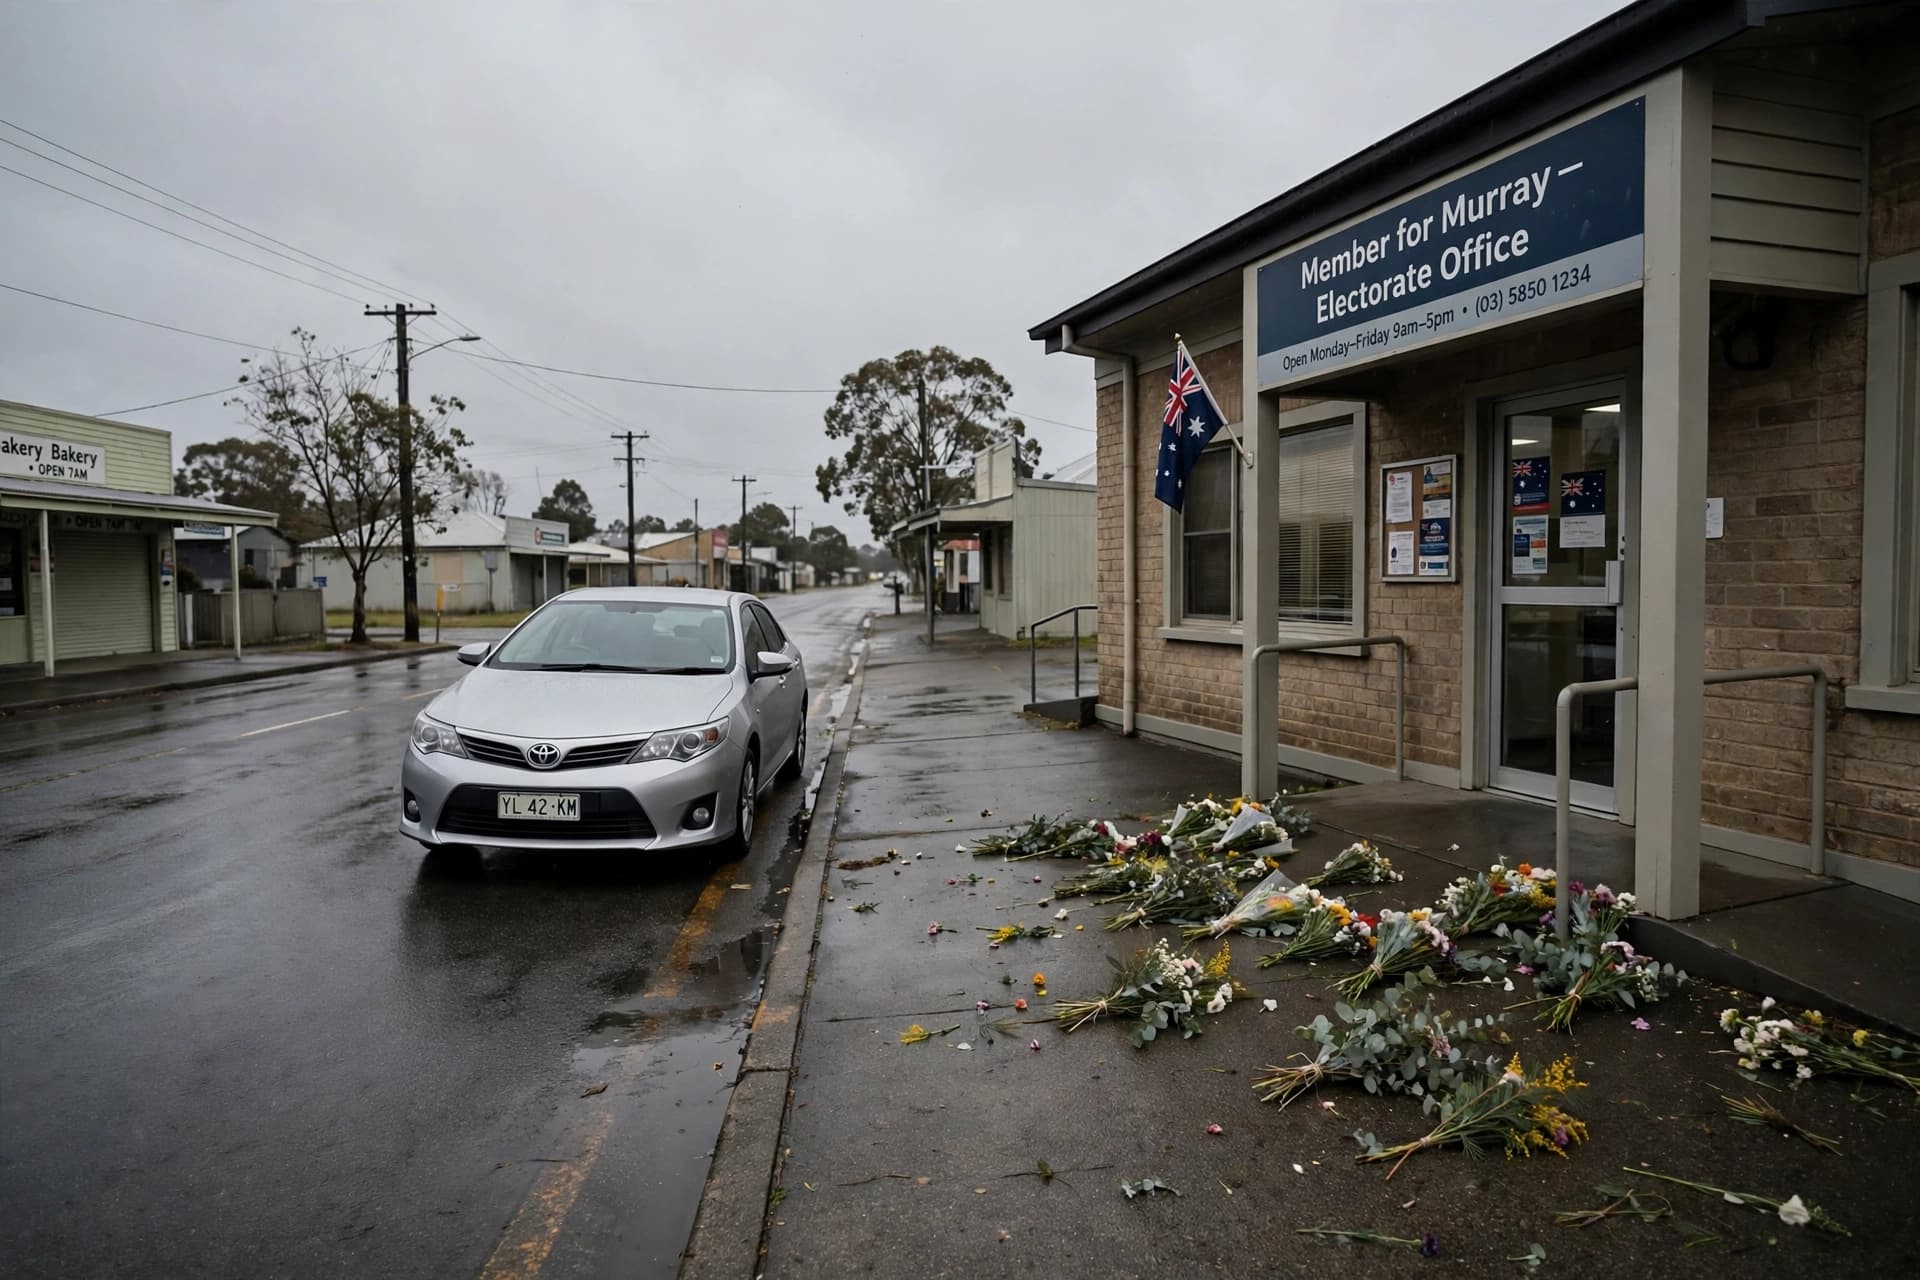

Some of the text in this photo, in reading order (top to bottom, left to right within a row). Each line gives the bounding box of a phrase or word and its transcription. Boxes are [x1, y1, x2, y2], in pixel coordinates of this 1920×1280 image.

[1301, 234, 1390, 289] Member
[1396, 217, 1433, 251] for
[1442, 166, 1551, 234] Murray
[1316, 228, 1529, 324] Electorate Office
[1282, 353, 1307, 372] Open
[1475, 290, 1503, 317] (03)
[1508, 278, 1546, 305] 5850
[1552, 264, 1591, 292] 1234
[1, 436, 97, 469] akery Bakery
[38, 463, 88, 480] OPEN 7AM
[502, 797, 521, 814] YL
